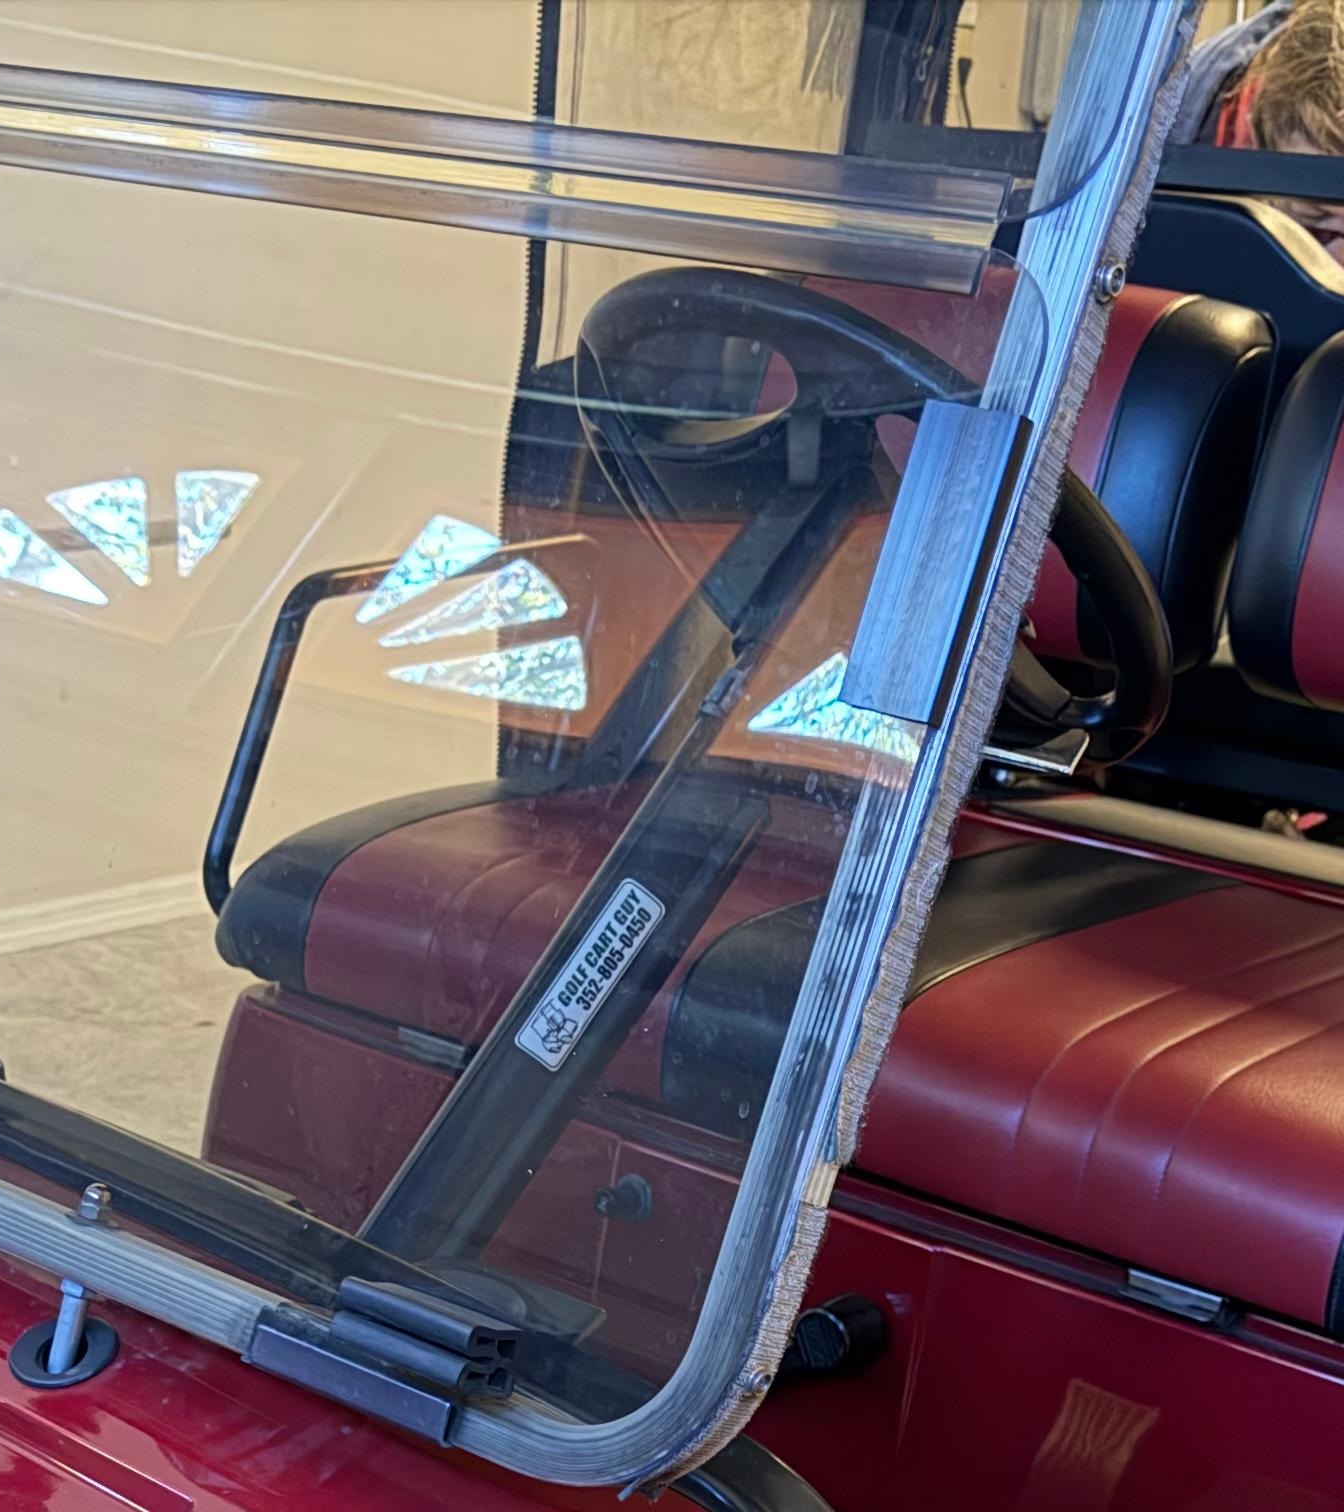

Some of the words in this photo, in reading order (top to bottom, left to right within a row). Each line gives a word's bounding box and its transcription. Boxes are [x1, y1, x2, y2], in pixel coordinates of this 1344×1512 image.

[557, 964, 589, 1008] GOLF
[586, 922, 619, 968] CART
[614, 889, 641, 927] GUY
[576, 907, 651, 1011] 352-805-0450
